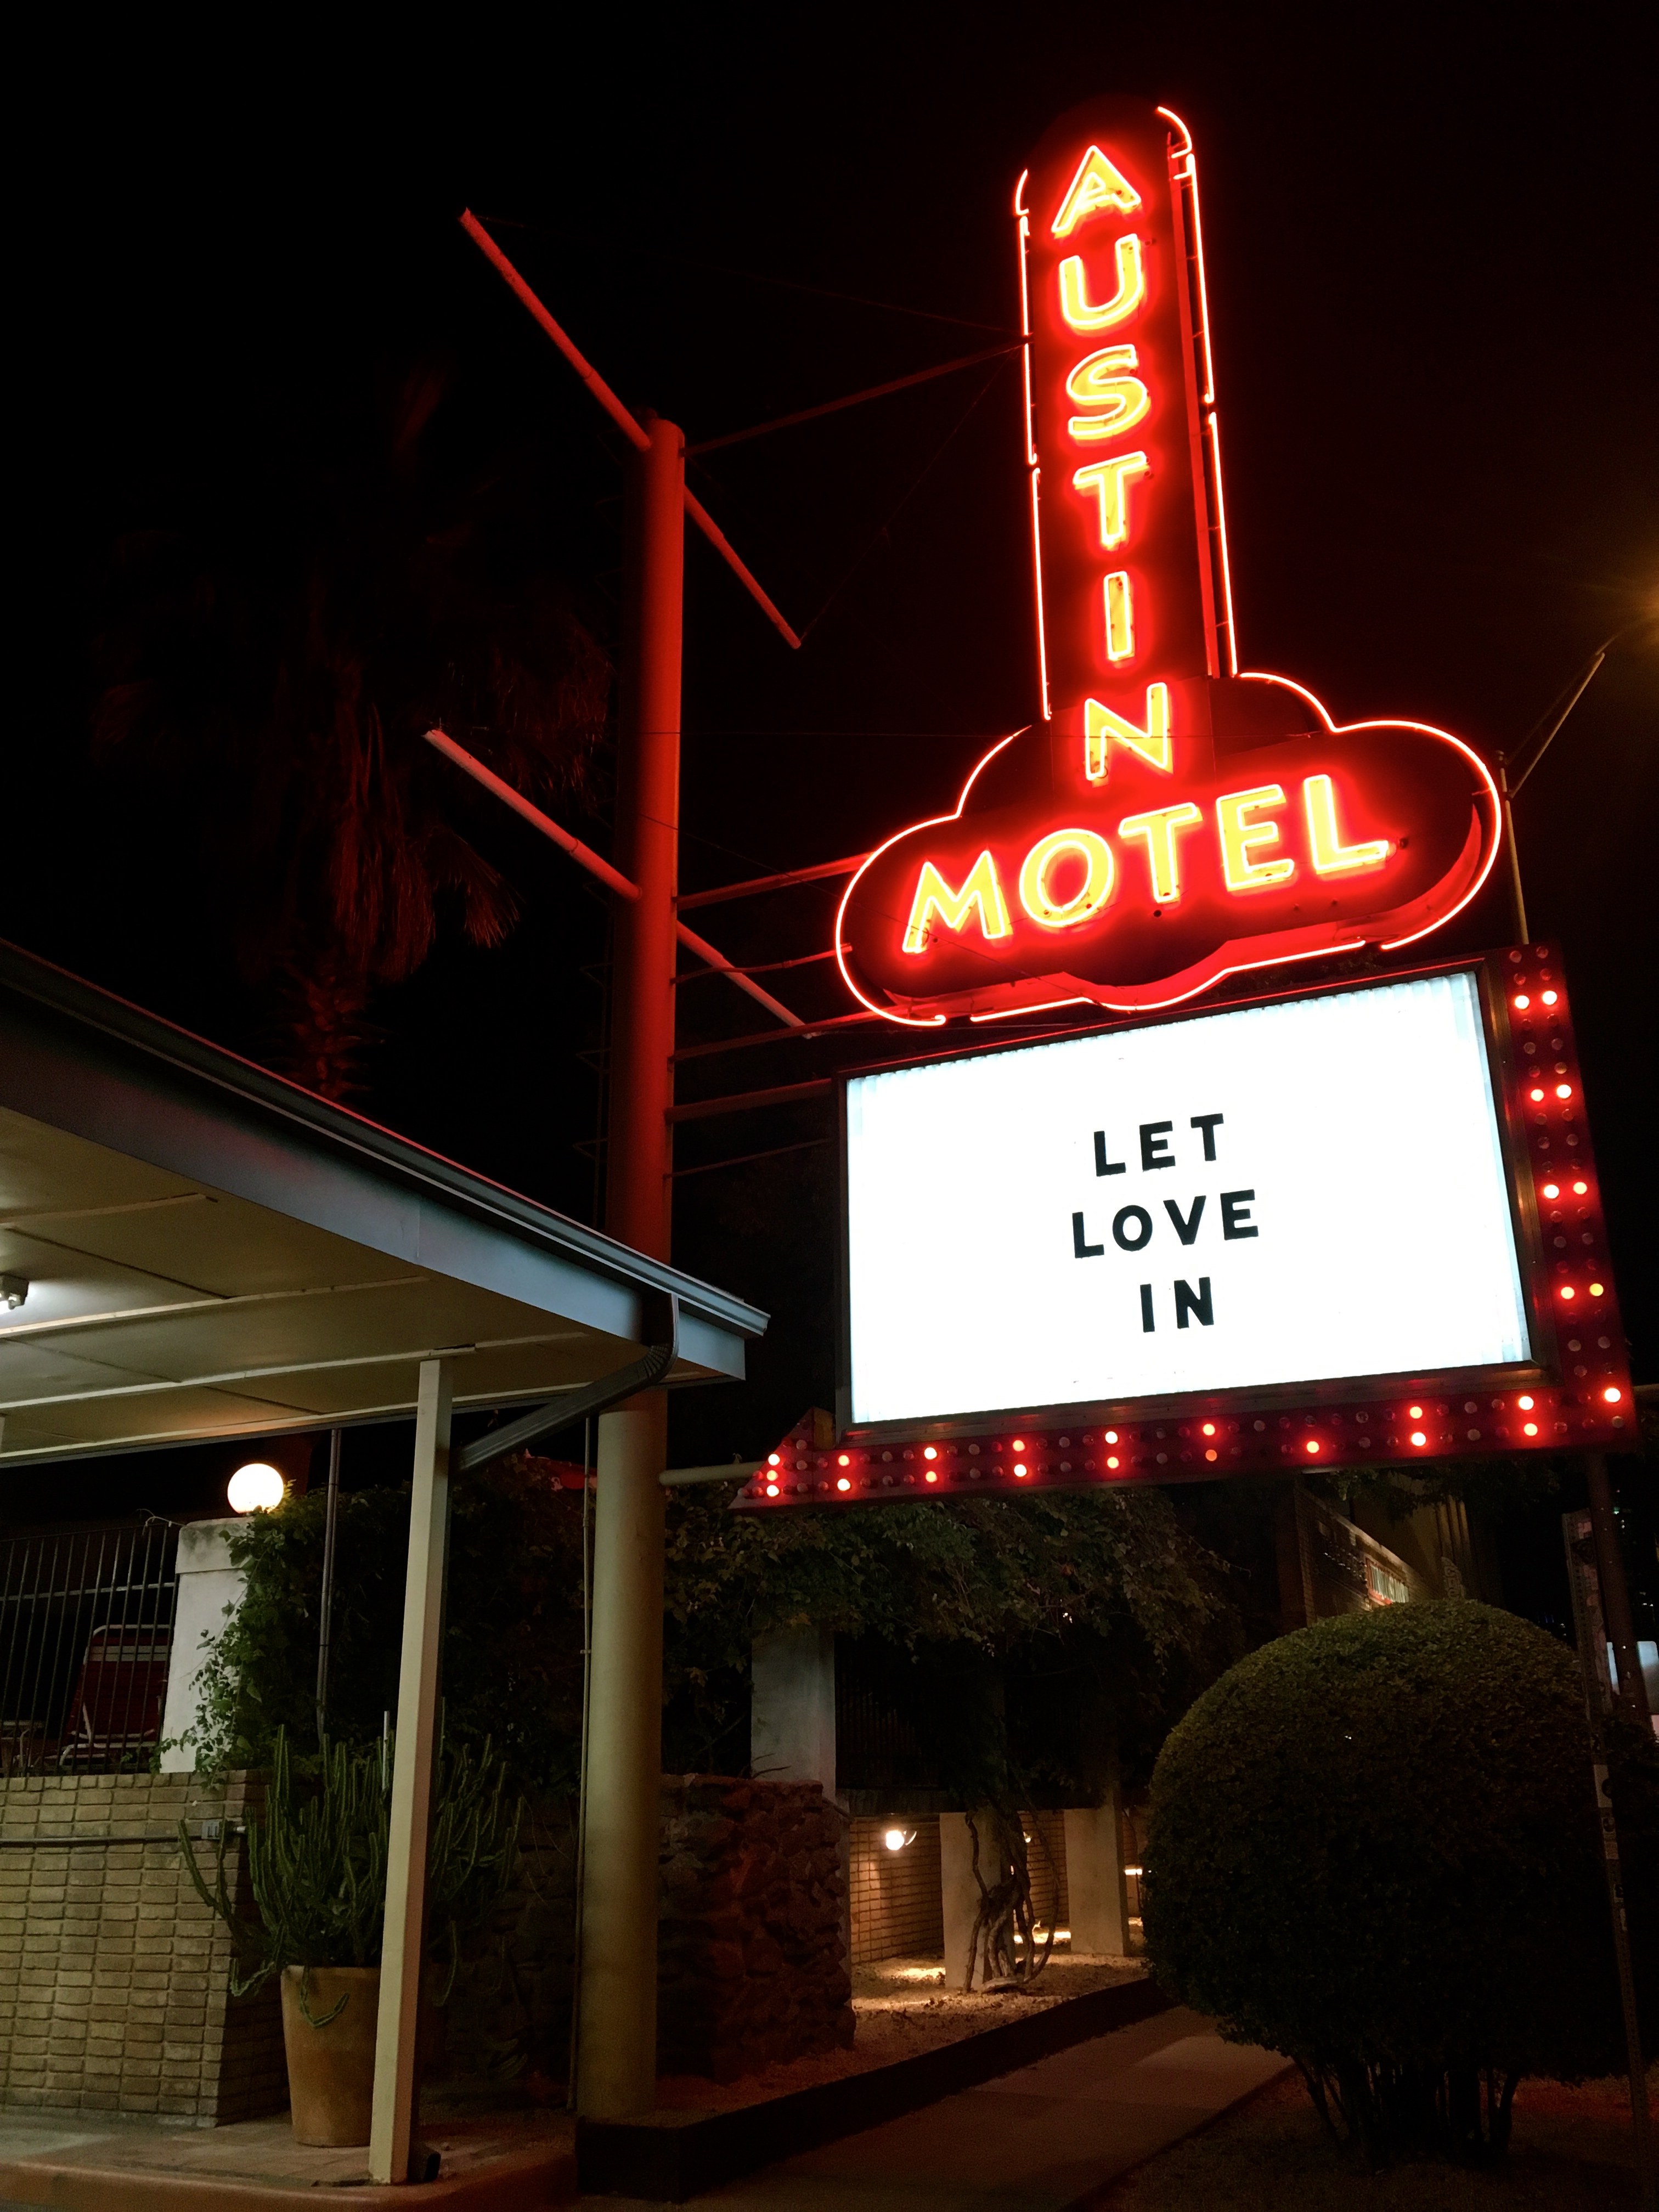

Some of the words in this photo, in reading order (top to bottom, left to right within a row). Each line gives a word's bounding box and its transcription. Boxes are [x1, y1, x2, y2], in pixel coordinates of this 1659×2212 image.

[1051, 145, 1173, 783] AUSTIN
[901, 773, 1390, 955] MOTEL
[1093, 1113, 1224, 1177] LET
[1071, 1189, 1259, 1259] LOVE
[1139, 1276, 1214, 1333] IN
